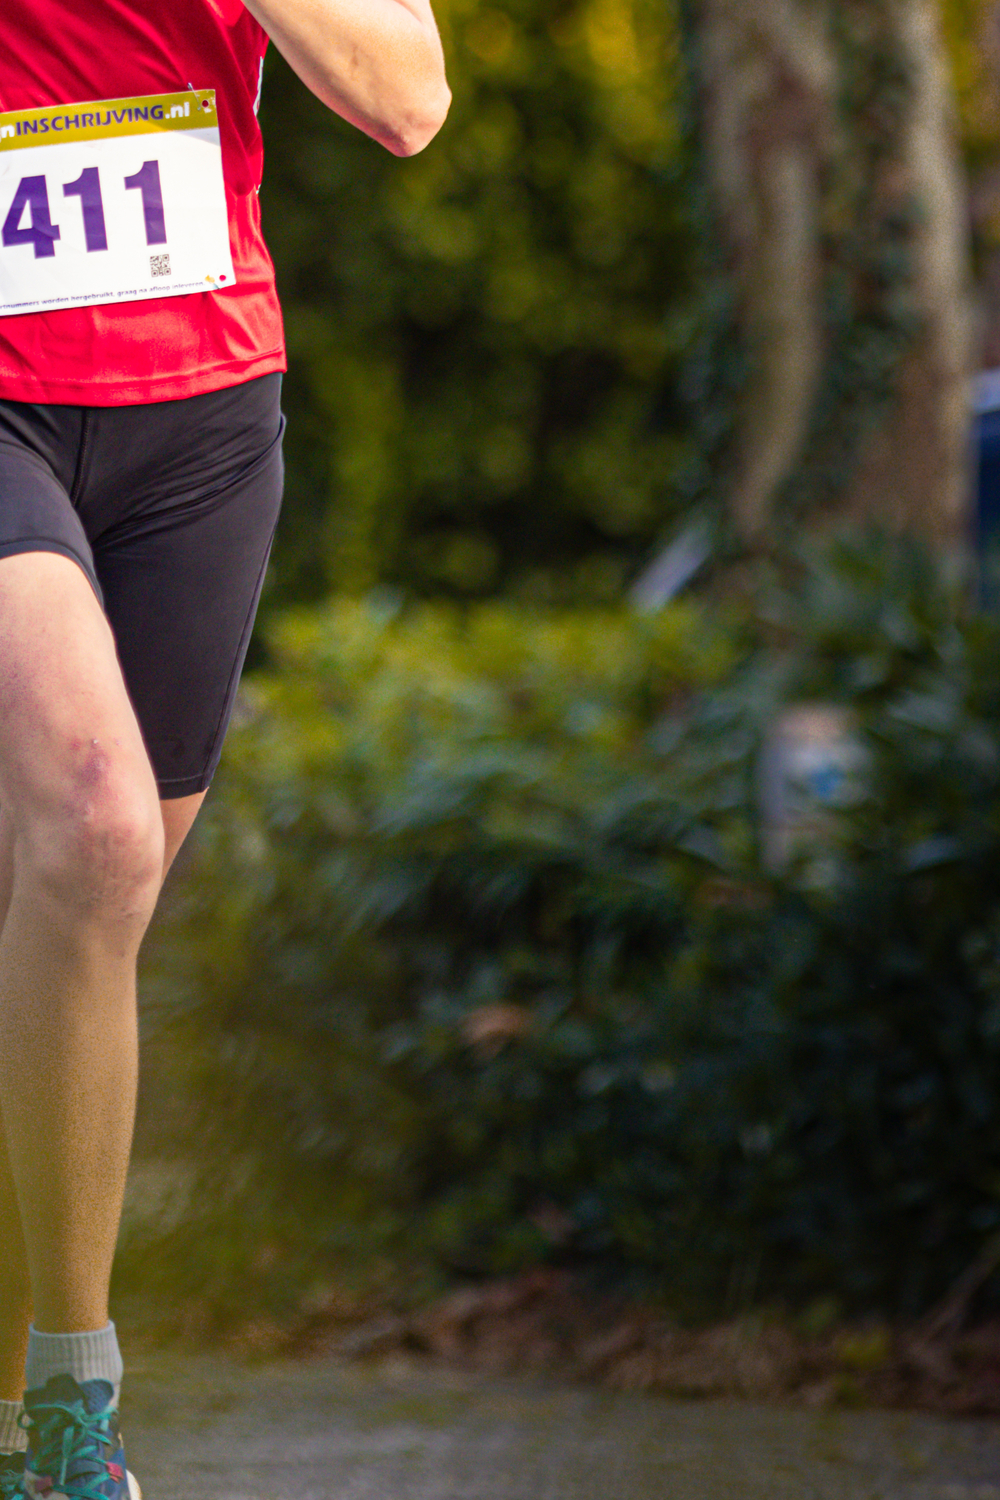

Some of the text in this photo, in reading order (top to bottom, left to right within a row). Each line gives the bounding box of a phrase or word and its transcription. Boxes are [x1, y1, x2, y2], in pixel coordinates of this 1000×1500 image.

[1, 159, 168, 260] 411
[116, 288, 137, 298] graag
[149, 284, 171, 293] afloop
